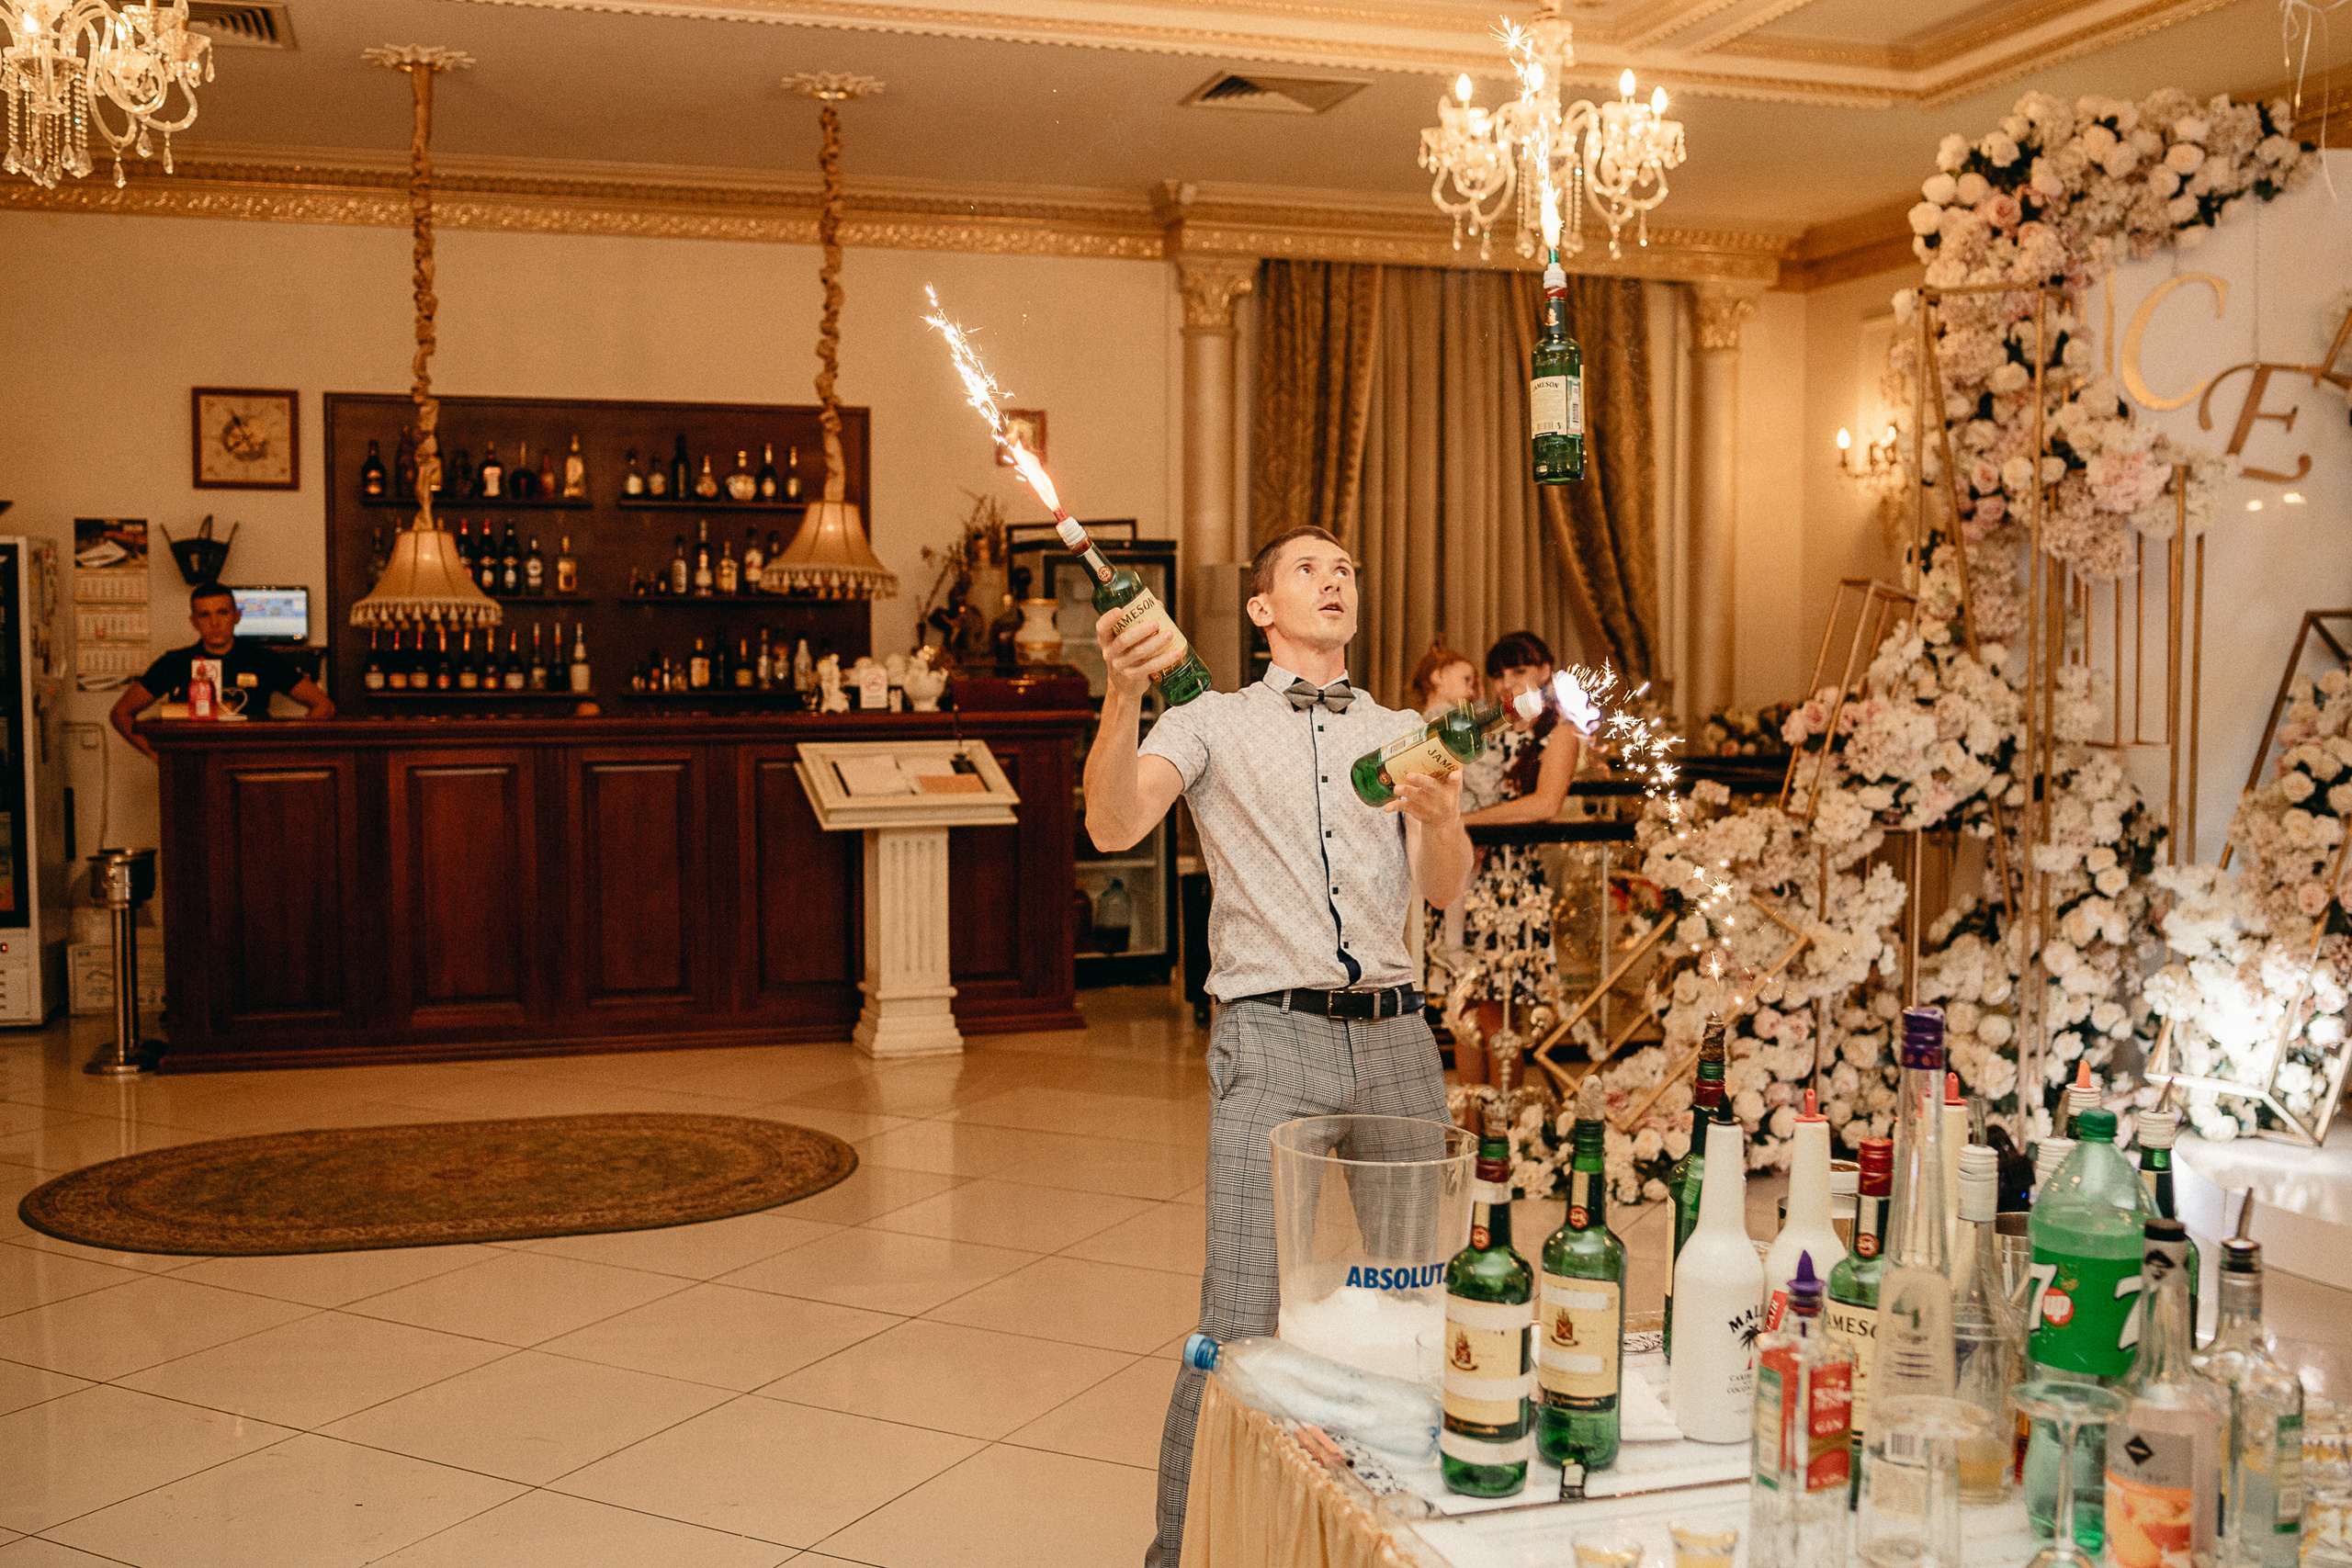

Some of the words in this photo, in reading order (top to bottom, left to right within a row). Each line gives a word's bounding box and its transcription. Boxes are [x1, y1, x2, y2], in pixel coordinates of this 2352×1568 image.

[2120, 274, 2230, 411] C
[1532, 380, 1559, 393] JAMESON
[1114, 596, 1156, 634] JAMESON
[1345, 1262, 1445, 1291] ABSOLUT
